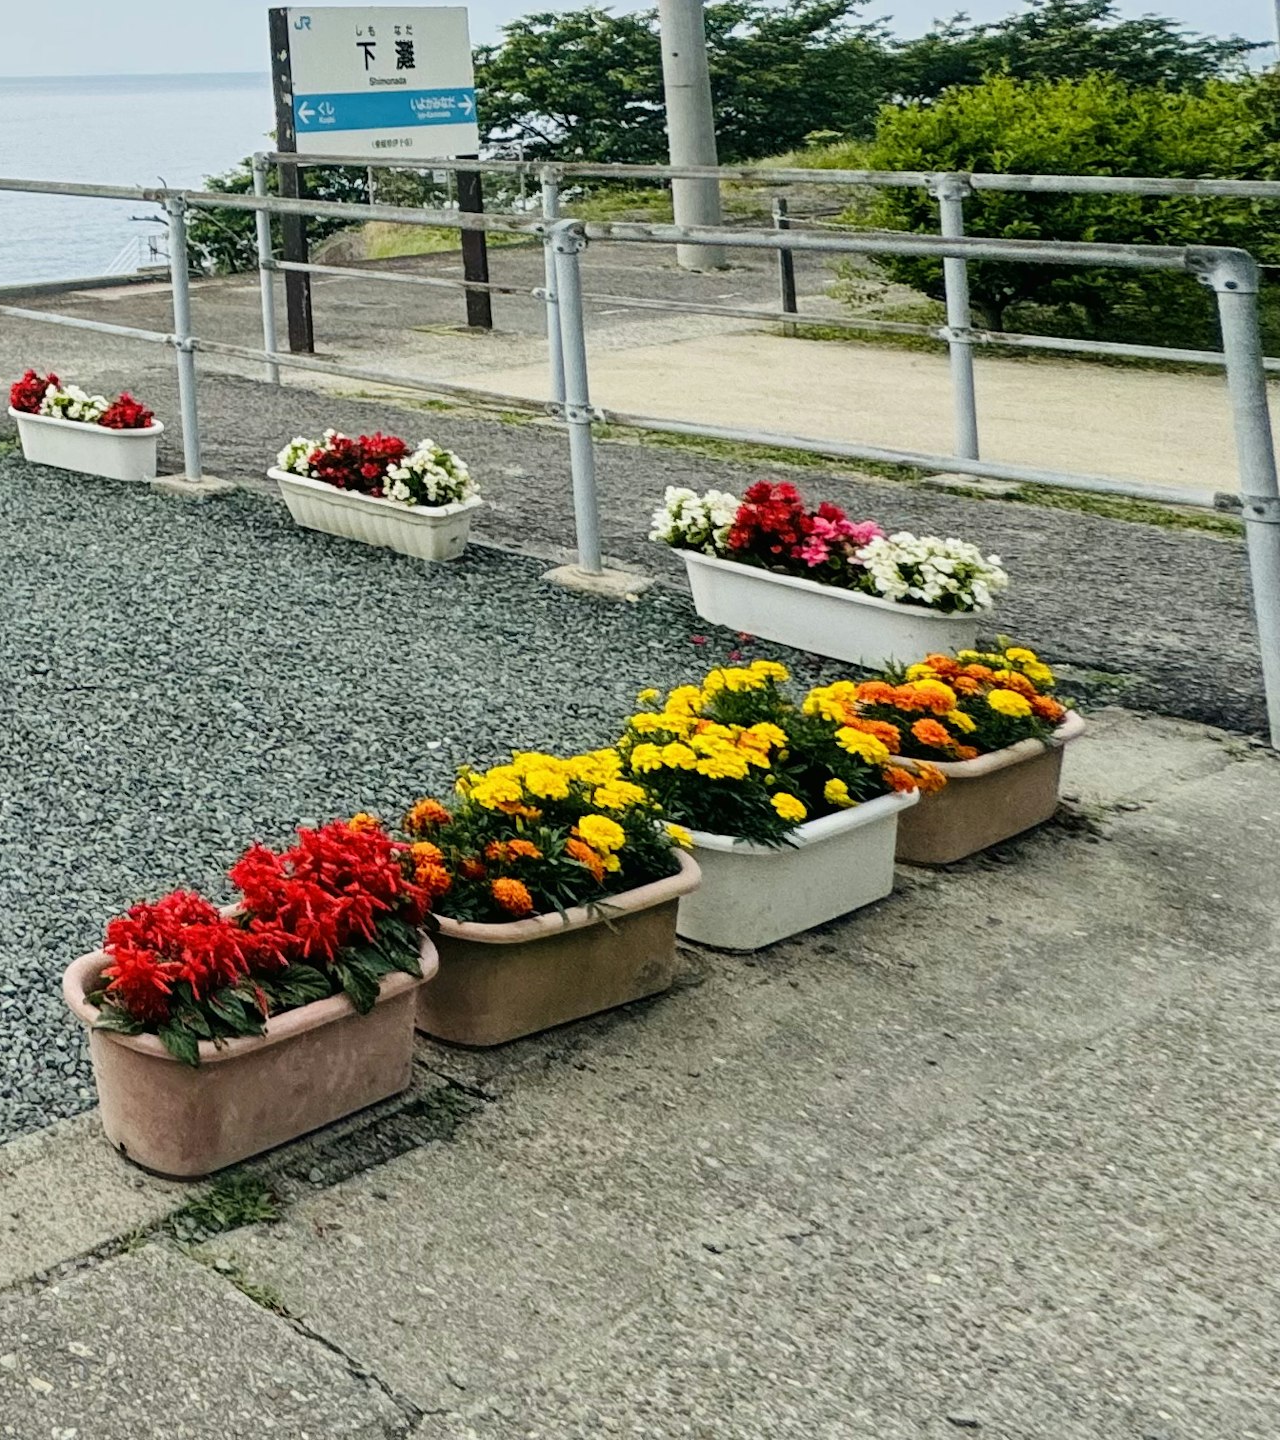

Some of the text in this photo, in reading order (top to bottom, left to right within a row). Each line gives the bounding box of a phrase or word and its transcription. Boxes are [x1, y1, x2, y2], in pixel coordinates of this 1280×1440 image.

[294, 16, 311, 30] JR
[356, 40, 416, 70] 下灘
[317, 101, 335, 115] くし
